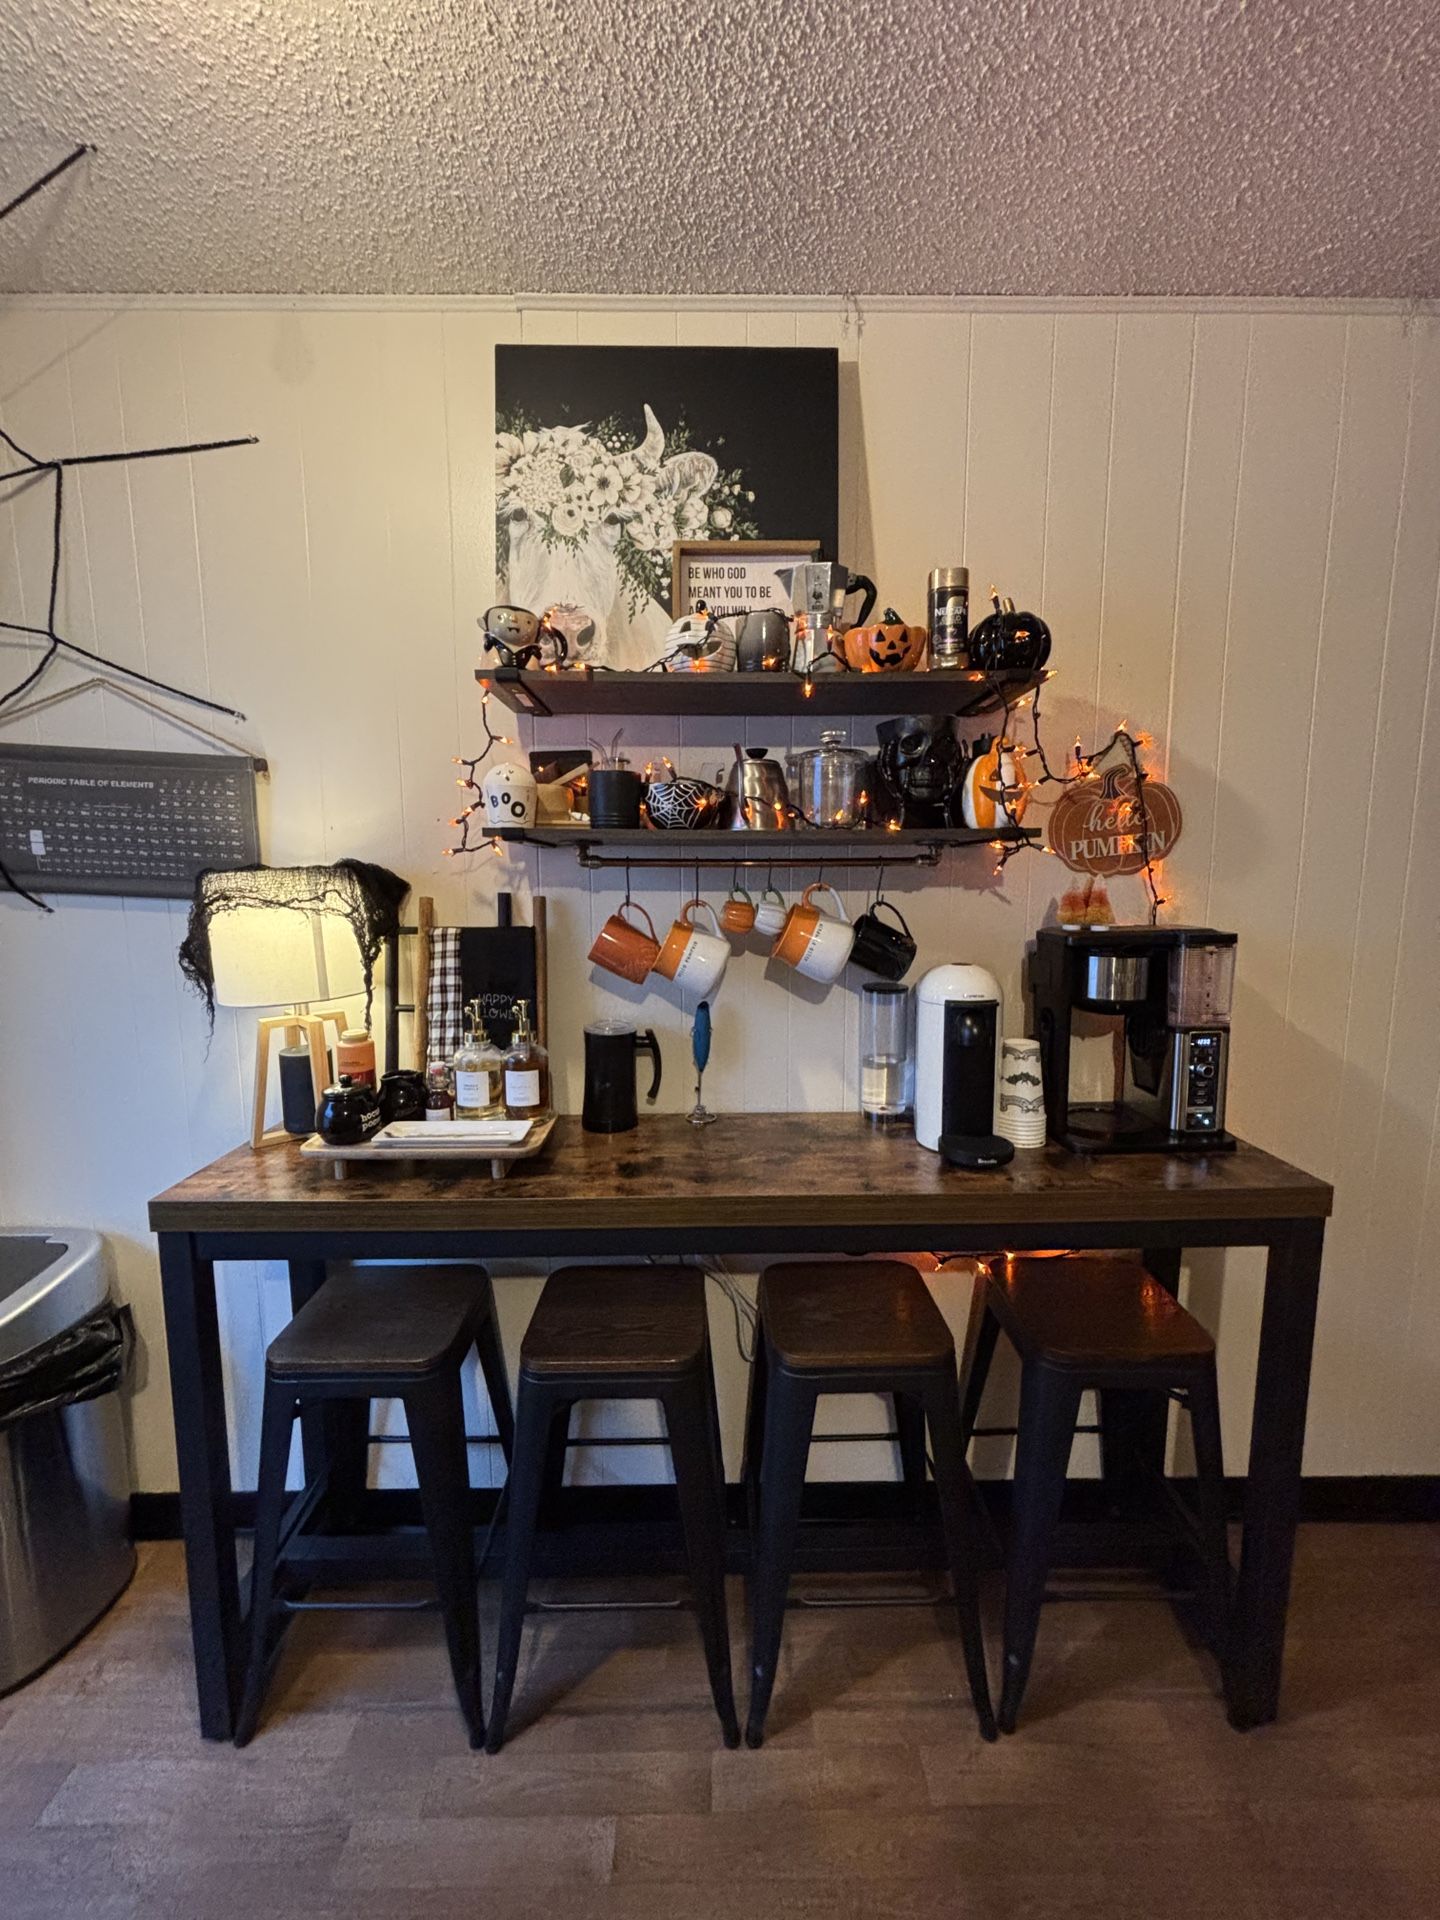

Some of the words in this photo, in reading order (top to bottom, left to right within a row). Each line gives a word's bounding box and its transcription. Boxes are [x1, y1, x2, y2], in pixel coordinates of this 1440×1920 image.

[688, 567, 700, 579] BE
[703, 567, 725, 579] WHO
[727, 567, 746, 579] GOD
[688, 586, 722, 598] MEANT
[724, 586, 742, 598] YOU
[745, 586, 757, 598] TO
[760, 586, 772, 598] BE
[28, 777, 67, 785] PERIODIC
[69, 778, 95, 787] TABLE
[110, 780, 154, 789] ELEMENTS
[490, 792, 525, 818] BOO
[478, 993, 514, 1006] HAPPY
